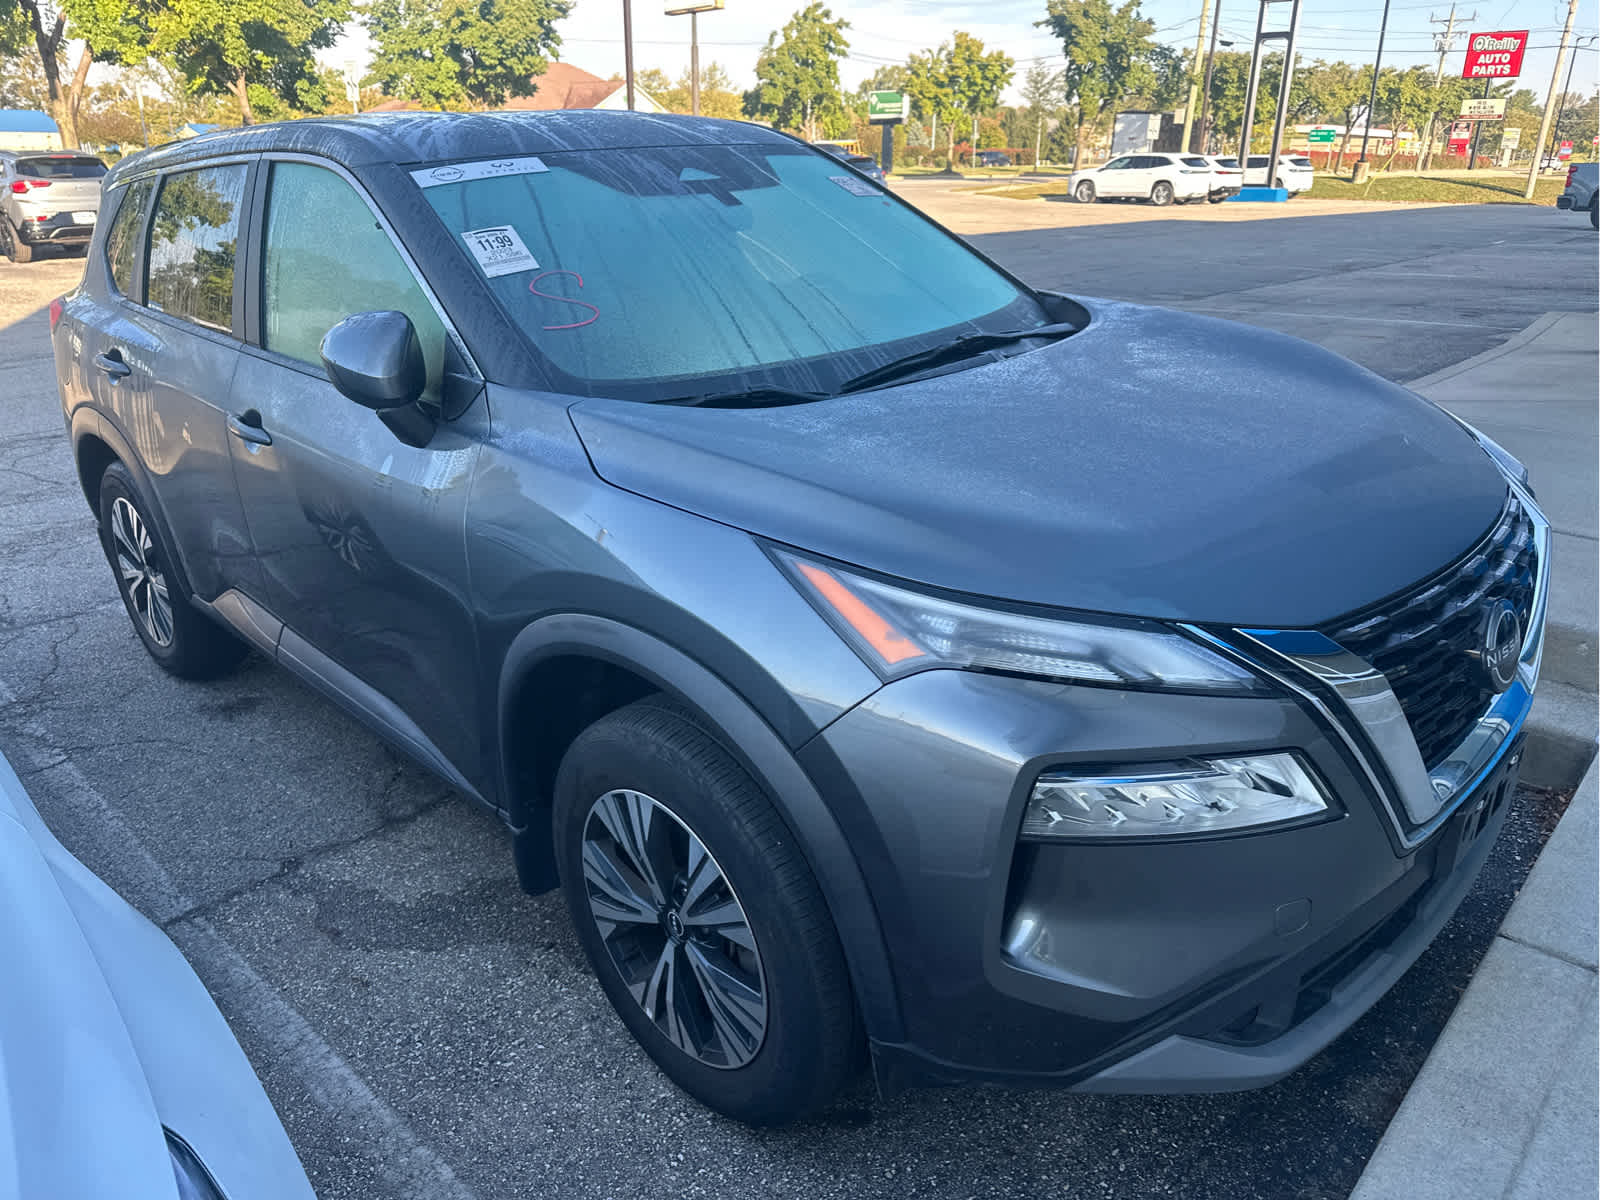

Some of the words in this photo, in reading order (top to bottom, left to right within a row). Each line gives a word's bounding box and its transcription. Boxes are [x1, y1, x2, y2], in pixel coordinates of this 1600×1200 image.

[1473, 36, 1520, 52] O'Reilly
[1477, 53, 1510, 64] AUTO
[1471, 64, 1511, 75] PARTS
[477, 235, 514, 251] 11:99
[529, 270, 600, 330] S
